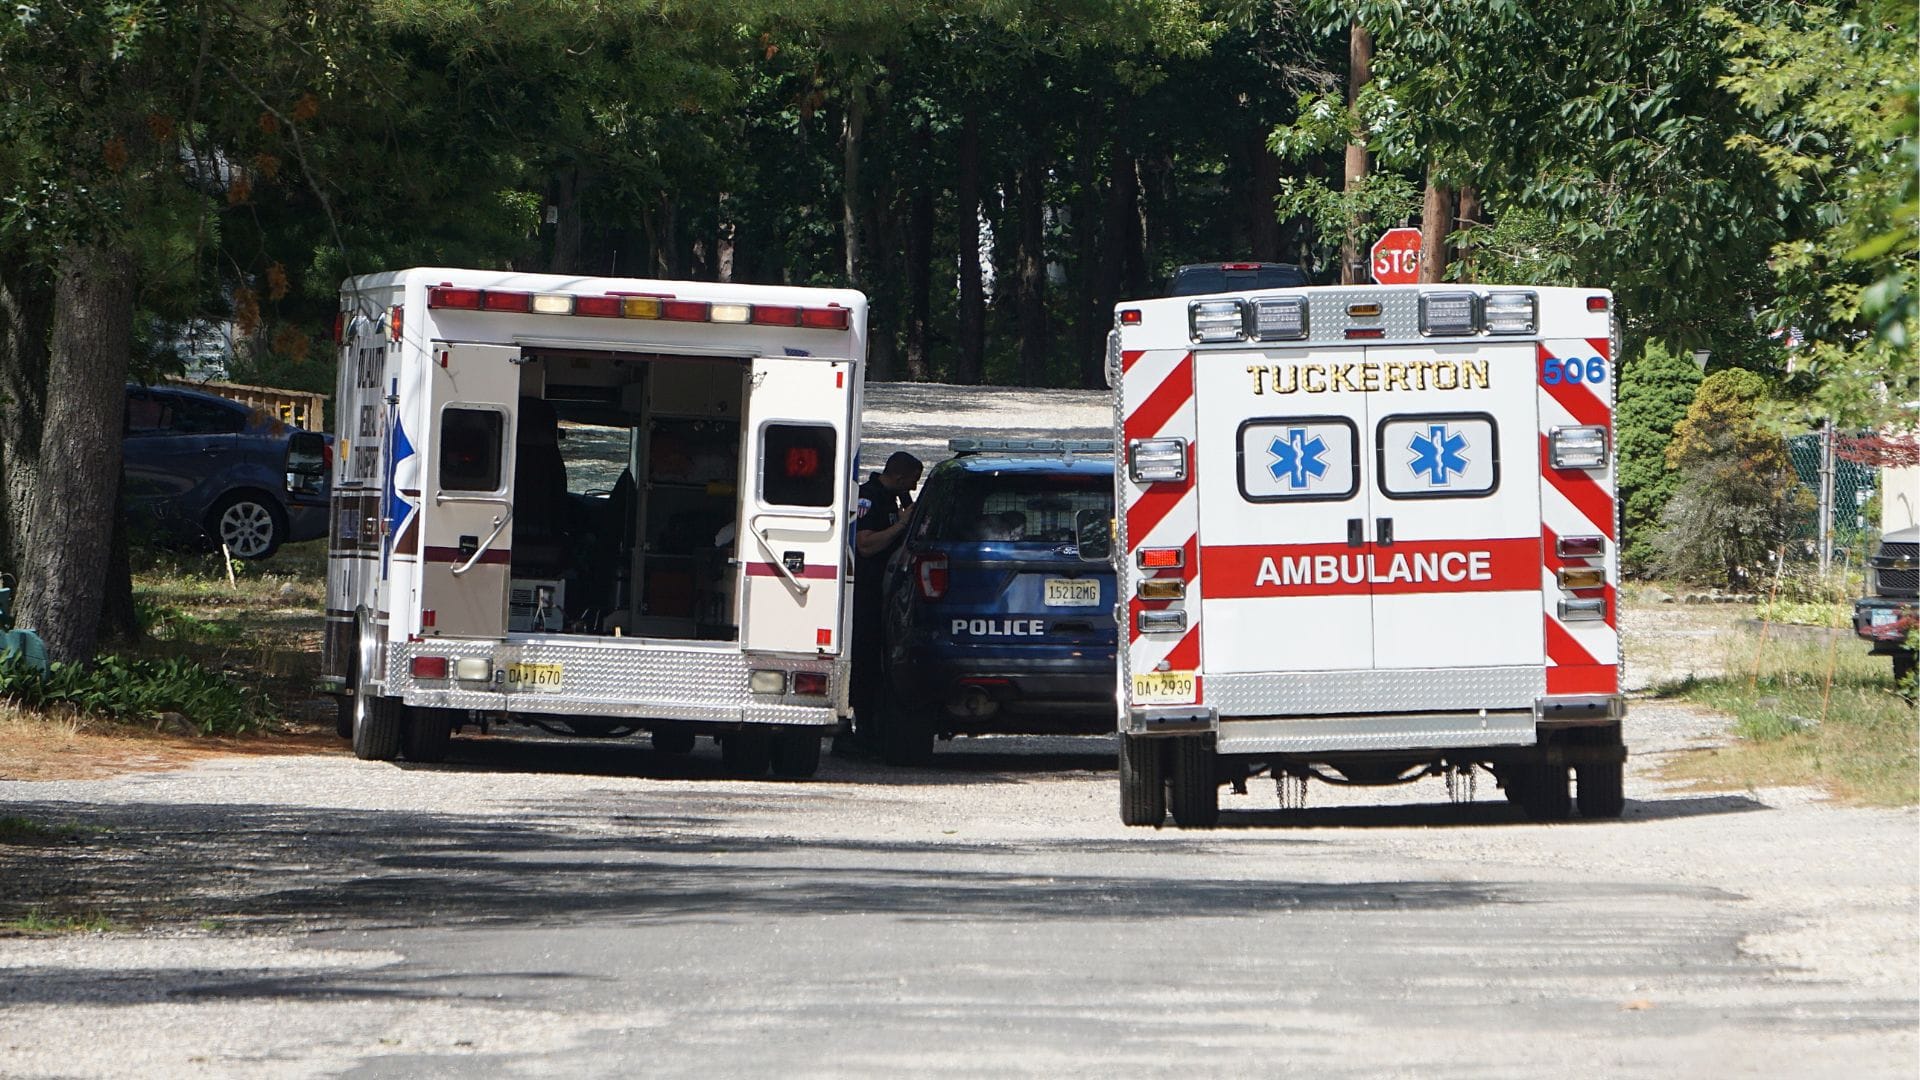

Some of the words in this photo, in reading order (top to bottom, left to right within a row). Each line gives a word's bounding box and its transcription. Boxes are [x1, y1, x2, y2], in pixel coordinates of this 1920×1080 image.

[1377, 248, 1422, 274] STO
[1246, 359, 1491, 396] TUCKERTON
[1542, 356, 1606, 385] 506
[1255, 551, 1492, 587] AMBULANCE
[1048, 585, 1097, 600] 15212MG
[951, 618, 1045, 636] POLICE
